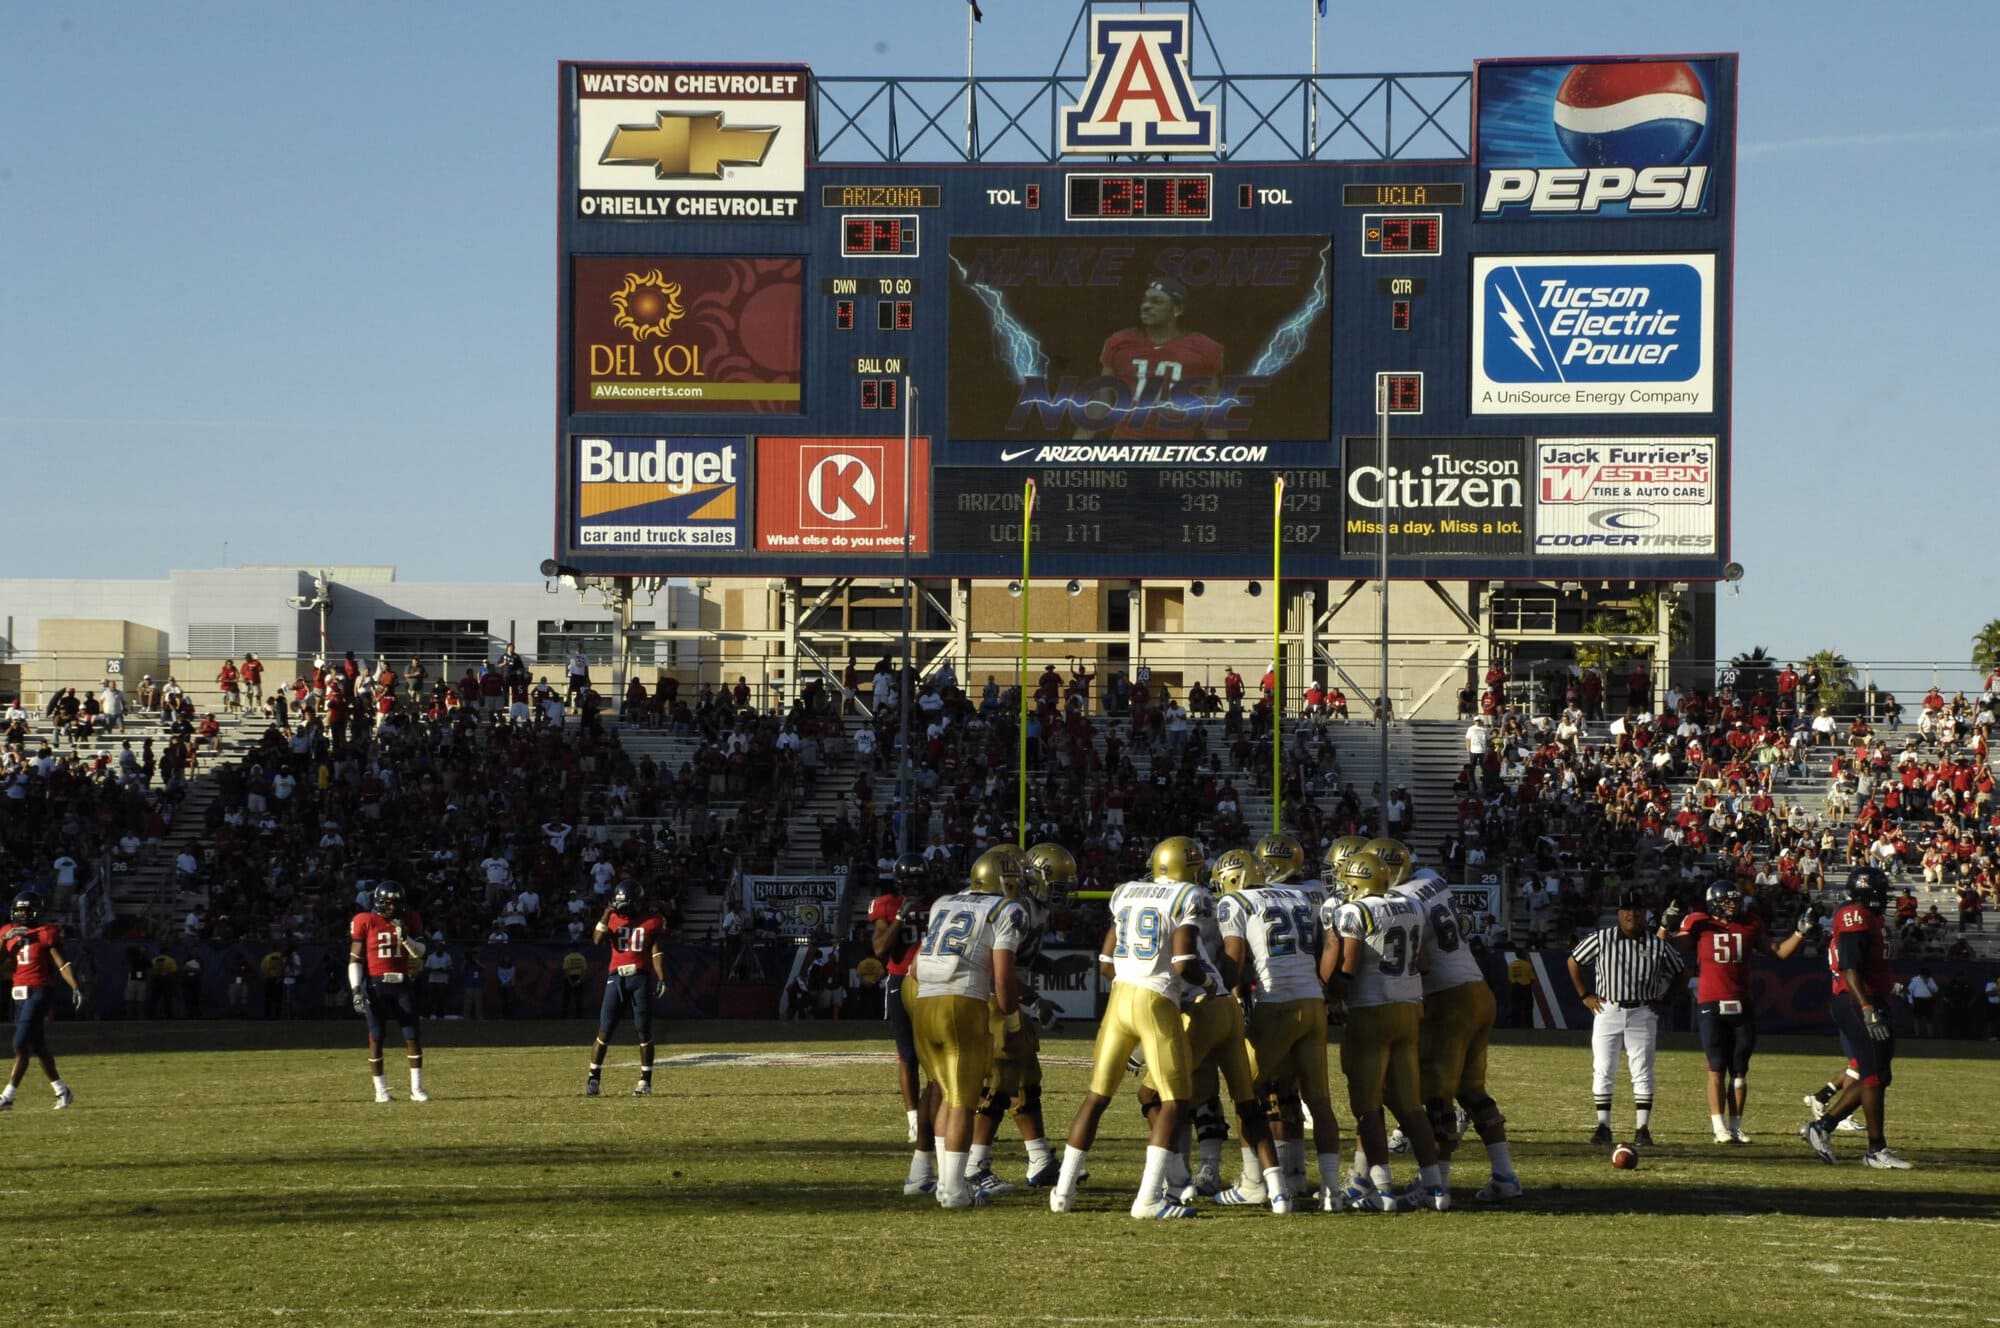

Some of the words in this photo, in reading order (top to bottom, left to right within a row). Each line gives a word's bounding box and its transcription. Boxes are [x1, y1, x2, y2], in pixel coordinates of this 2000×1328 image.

[583, 75, 669, 93] WATSON
[674, 75, 798, 94] CHEVROLET
[1061, 14, 1216, 152] A
[843, 188, 920, 207] ARIZONA
[987, 189, 1021, 205] TOL
[1102, 178, 1208, 214] 2:12
[1258, 189, 1292, 205] TOL
[1377, 187, 1426, 205] UCLA
[1481, 166, 1707, 213] PEPSI
[581, 197, 668, 216] O'RIELLY
[676, 198, 798, 216] CHEVROLET
[847, 220, 899, 251] 34
[1382, 219, 1438, 250] 27
[967, 248, 1134, 287] MAKE
[1154, 248, 1312, 287] SOME
[833, 279, 856, 294] DWN
[880, 279, 892, 294] TO
[896, 279, 911, 294] GO
[1391, 279, 1412, 295] QTR
[1538, 280, 1650, 308] Tucson
[838, 302, 853, 328] 4
[1394, 301, 1409, 328] 4
[1549, 309, 1680, 336] Electric
[591, 345, 641, 376] DEL
[654, 345, 705, 376] SOL
[1562, 338, 1679, 365] Power
[858, 358, 882, 373] BALL
[885, 359, 900, 373] ON
[595, 384, 703, 398] AVAconcerts.com
[1482, 391, 1493, 403] A
[1497, 390, 1571, 404] UniSource
[1576, 390, 1626, 406] Energy
[1630, 389, 1699, 406] Company
[1006, 375, 1271, 432] NOISE
[1035, 446, 1267, 463] ARIZONAATHLETICS.COM
[1543, 448, 1600, 464] Jack
[1609, 448, 1708, 464] Furrier's
[581, 439, 737, 494] Budget
[1432, 454, 1519, 475] Tucson
[1043, 470, 1128, 488] RUSHING
[1159, 470, 1243, 488] PASSING
[1348, 465, 1523, 508] Citizen
[1543, 466, 1708, 500] WESTERN
[1065, 493, 1101, 511] 136
[1181, 493, 1218, 512] 343
[1283, 494, 1320, 511] 479
[1592, 488, 1620, 497] TIRE
[1624, 488, 1632, 497] &
[1637, 488, 1669, 497] AUTO
[1673, 488, 1705, 498] CARE
[583, 531, 608, 542] car
[614, 529, 641, 543] and
[647, 529, 686, 543] truck
[692, 529, 733, 543] sales
[990, 525, 1040, 542] UCLA
[1283, 525, 1320, 543] 287
[1347, 520, 1385, 534] Miss
[1388, 523, 1399, 534] a
[1403, 520, 1435, 536] day.
[1440, 520, 1479, 533] Miss
[1482, 523, 1493, 533] a
[1497, 521, 1522, 534] lot.
[766, 534, 800, 546] What
[802, 534, 829, 546] else
[832, 535, 849, 546] do
[851, 537, 874, 548] you
[107, 660, 120, 673] 26
[1723, 671, 1735, 684] 29
[112, 862, 128, 872] 26
[833, 864, 849, 875] 28
[1481, 873, 1498, 884] 29
[755, 882, 836, 899] BRUEGGER'S
[617, 926, 645, 952] 20
[1113, 906, 1162, 960] 19
[378, 932, 403, 958] 21
[1713, 933, 1742, 964] 51
[1044, 973, 1088, 991] MILK
